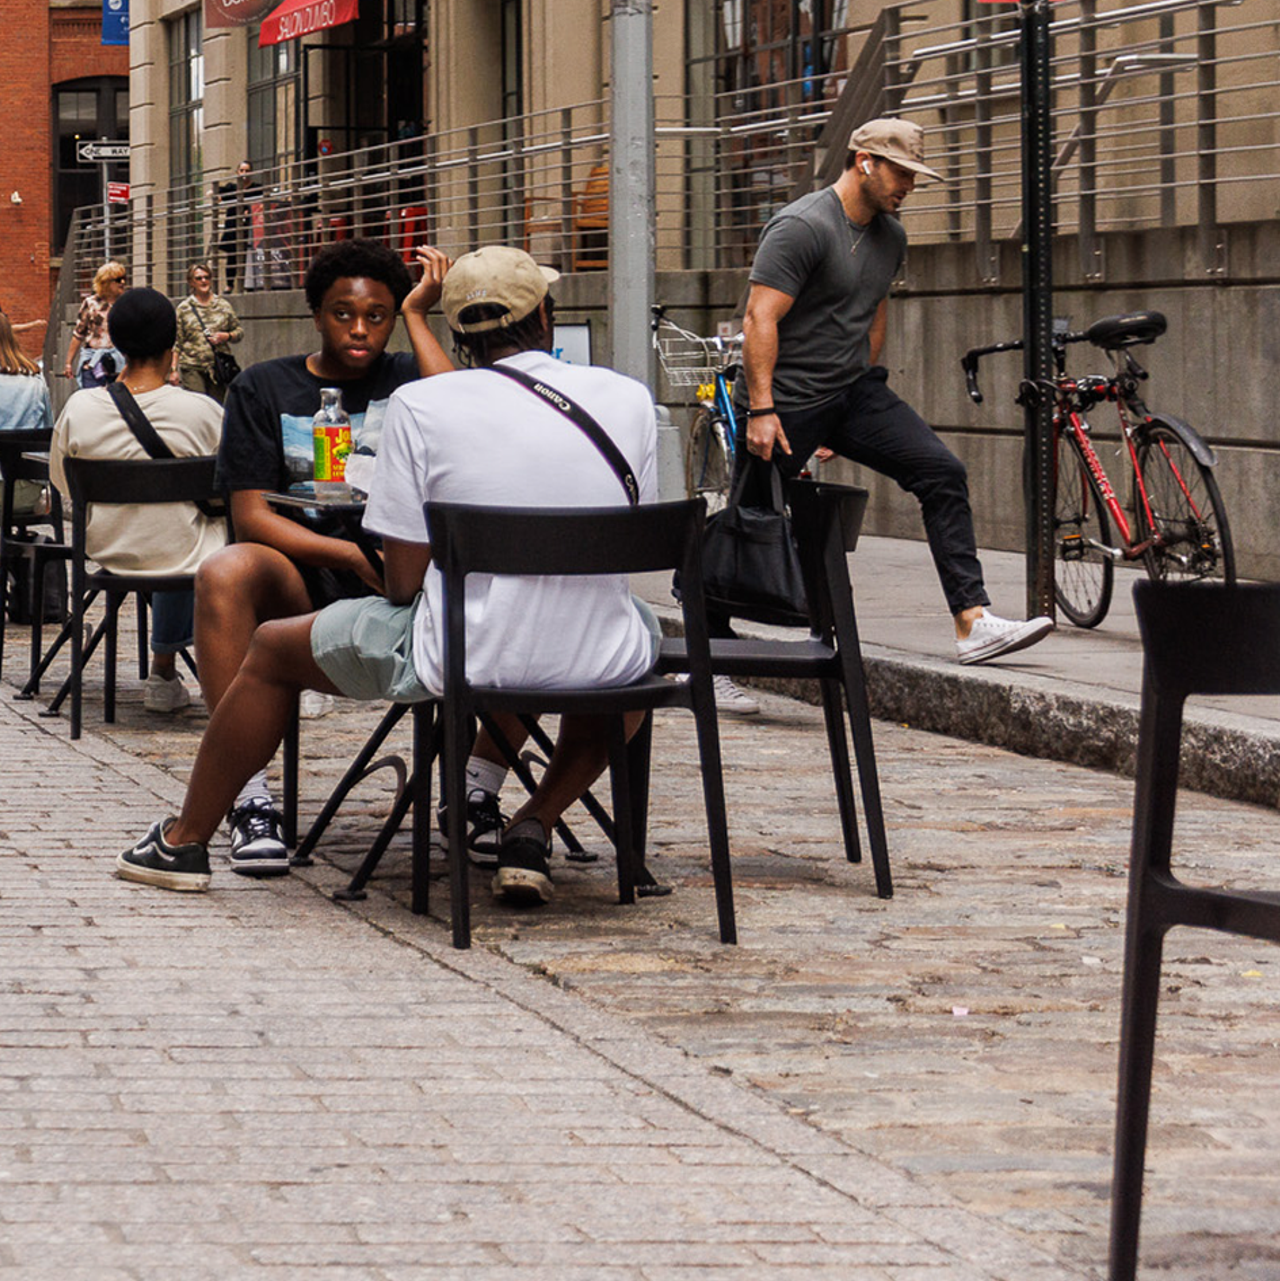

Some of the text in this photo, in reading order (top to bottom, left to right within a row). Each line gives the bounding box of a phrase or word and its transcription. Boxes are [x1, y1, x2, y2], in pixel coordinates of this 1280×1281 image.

[277, 0, 336, 41] SALON DUMBO
[84, 147, 101, 156] ONE
[533, 382, 572, 411] Canon
